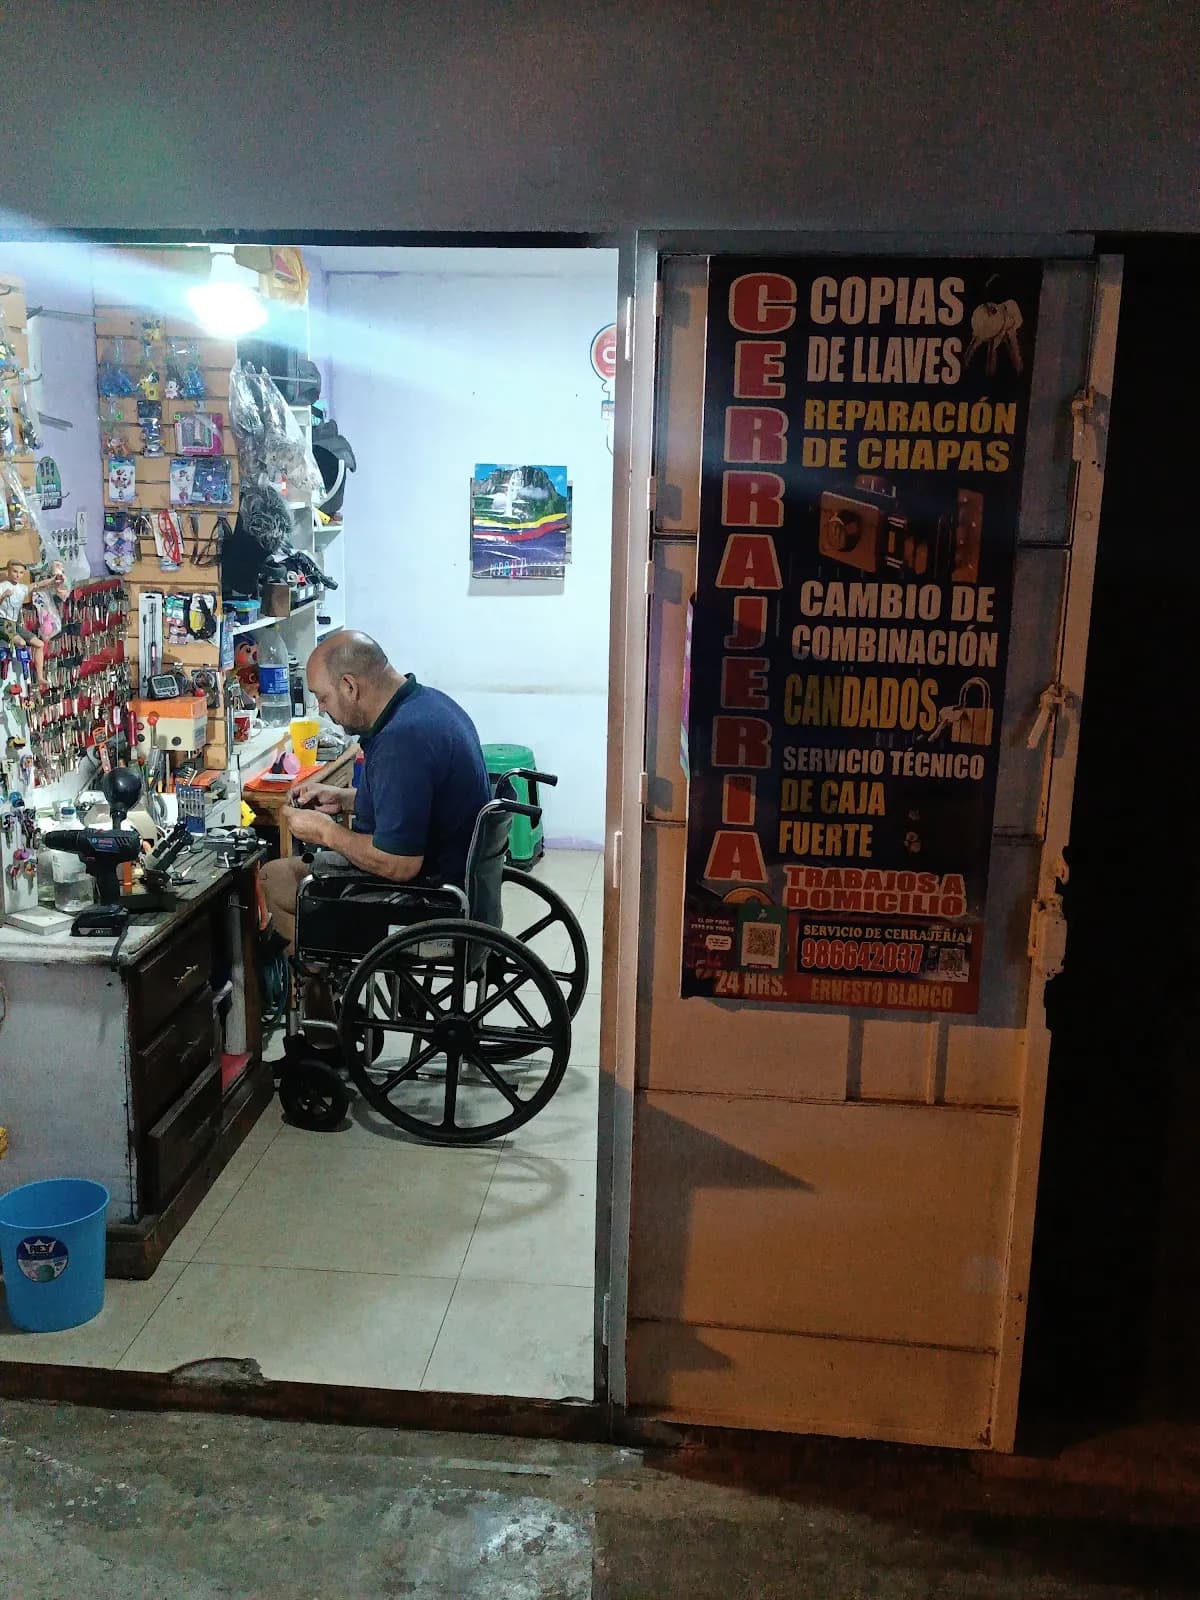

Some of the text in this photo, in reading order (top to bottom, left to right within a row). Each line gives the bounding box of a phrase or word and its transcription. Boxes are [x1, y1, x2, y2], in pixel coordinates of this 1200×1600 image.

[810, 276, 965, 326] COPIAS
[807, 336, 963, 385] DE LLAVES
[804, 397, 1017, 435] REPARACIÓN
[802, 437, 1010, 472] DE CHAPAS
[800, 581, 996, 622] CAMBIO DE
[791, 625, 999, 667] COMBINACIÓN
[784, 674, 939, 732] CANDADOS
[783, 747, 985, 780] SERVICIO TÉCNICO
[780, 778, 886, 816] DE CAJA
[778, 821, 874, 858] FUERTE
[783, 866, 966, 898] TRABAJOS A
[783, 886, 968, 916] DOMICILIO
[803, 924, 863, 938] SERVICIO
[864, 927, 881, 939] DE
[801, 938, 924, 975] 986642037
[716, 970, 740, 993] 24
[811, 977, 953, 1009] ERNESTO BLANCO
